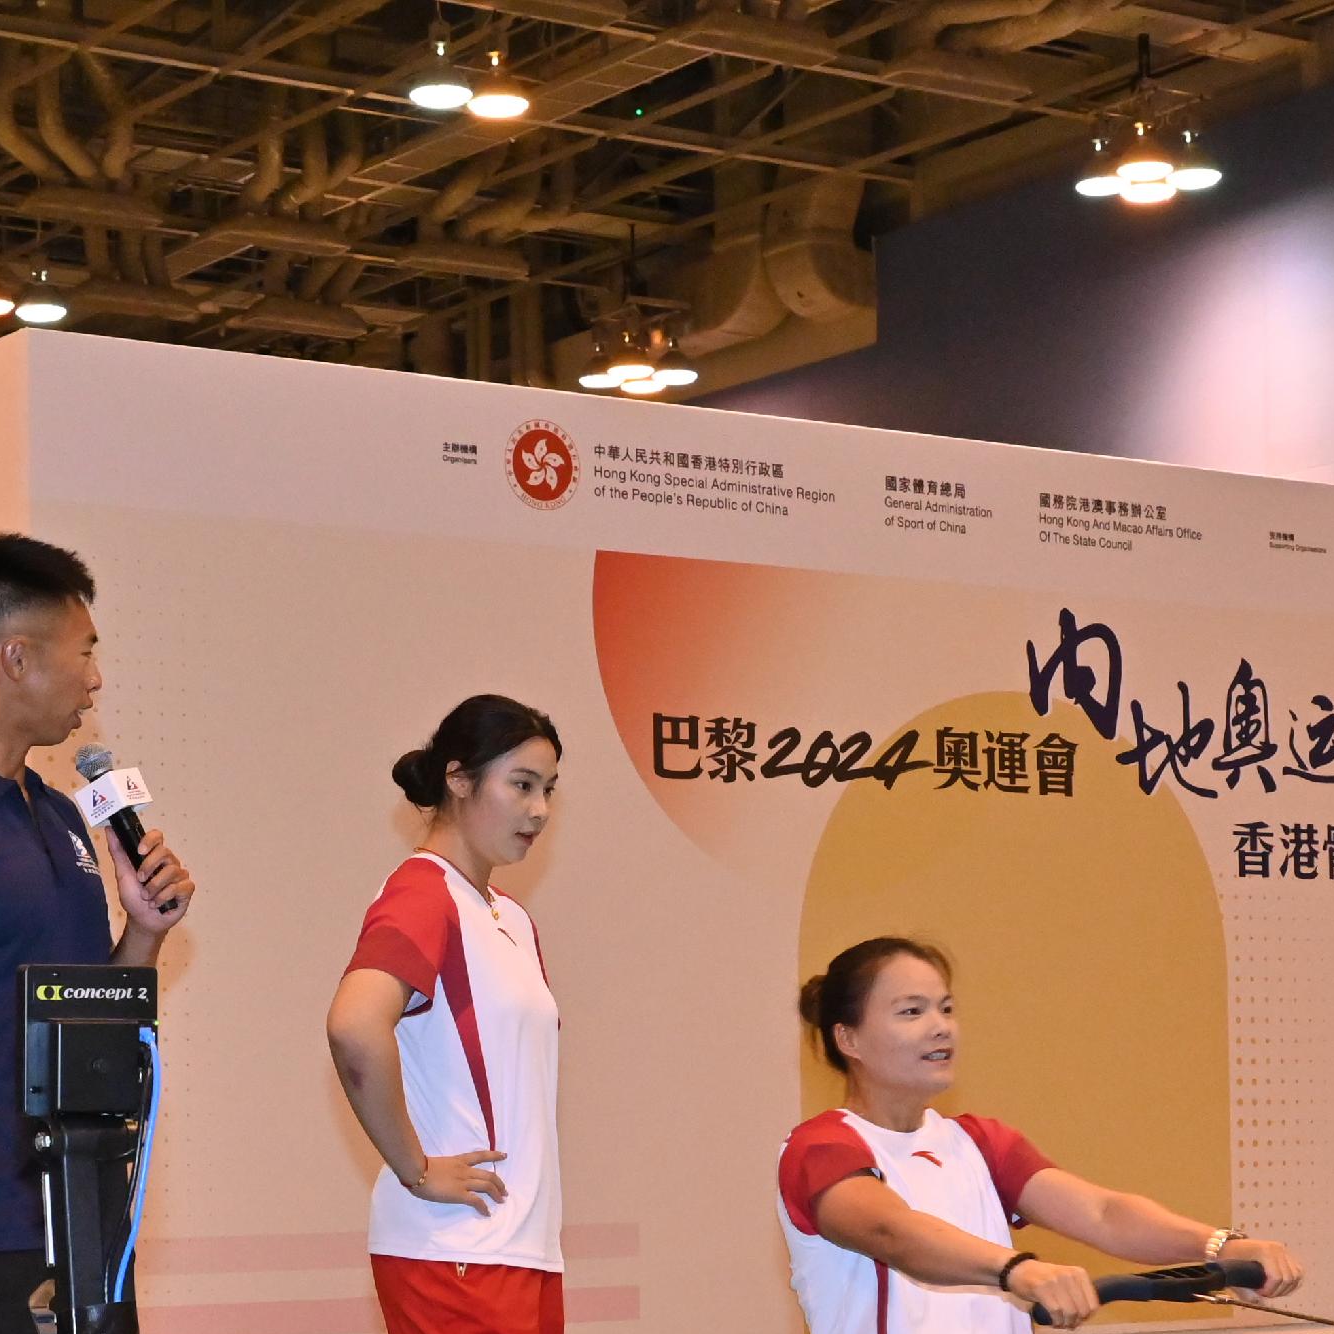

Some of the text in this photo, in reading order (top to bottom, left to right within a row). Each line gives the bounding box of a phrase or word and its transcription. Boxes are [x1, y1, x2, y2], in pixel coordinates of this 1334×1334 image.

[593, 444, 785, 479] 中華人民共和國香港特別行政區
[594, 466, 836, 504] Hong Kong Special Administrative Region
[885, 475, 967, 499] 國家體育總局
[594, 486, 789, 517] of the People's Republic of China
[885, 496, 993, 519] General Administration
[1038, 492, 1168, 521] 國務院港澳事務辦公室
[885, 516, 967, 535] of Sport of China
[1038, 514, 1203, 541] Hong Kong And Macao Affairs Office
[1039, 531, 1133, 552] Of The State Council
[652, 713, 1079, 798] 巴黎2024奧運會
[64, 987, 147, 1000] concept 2
